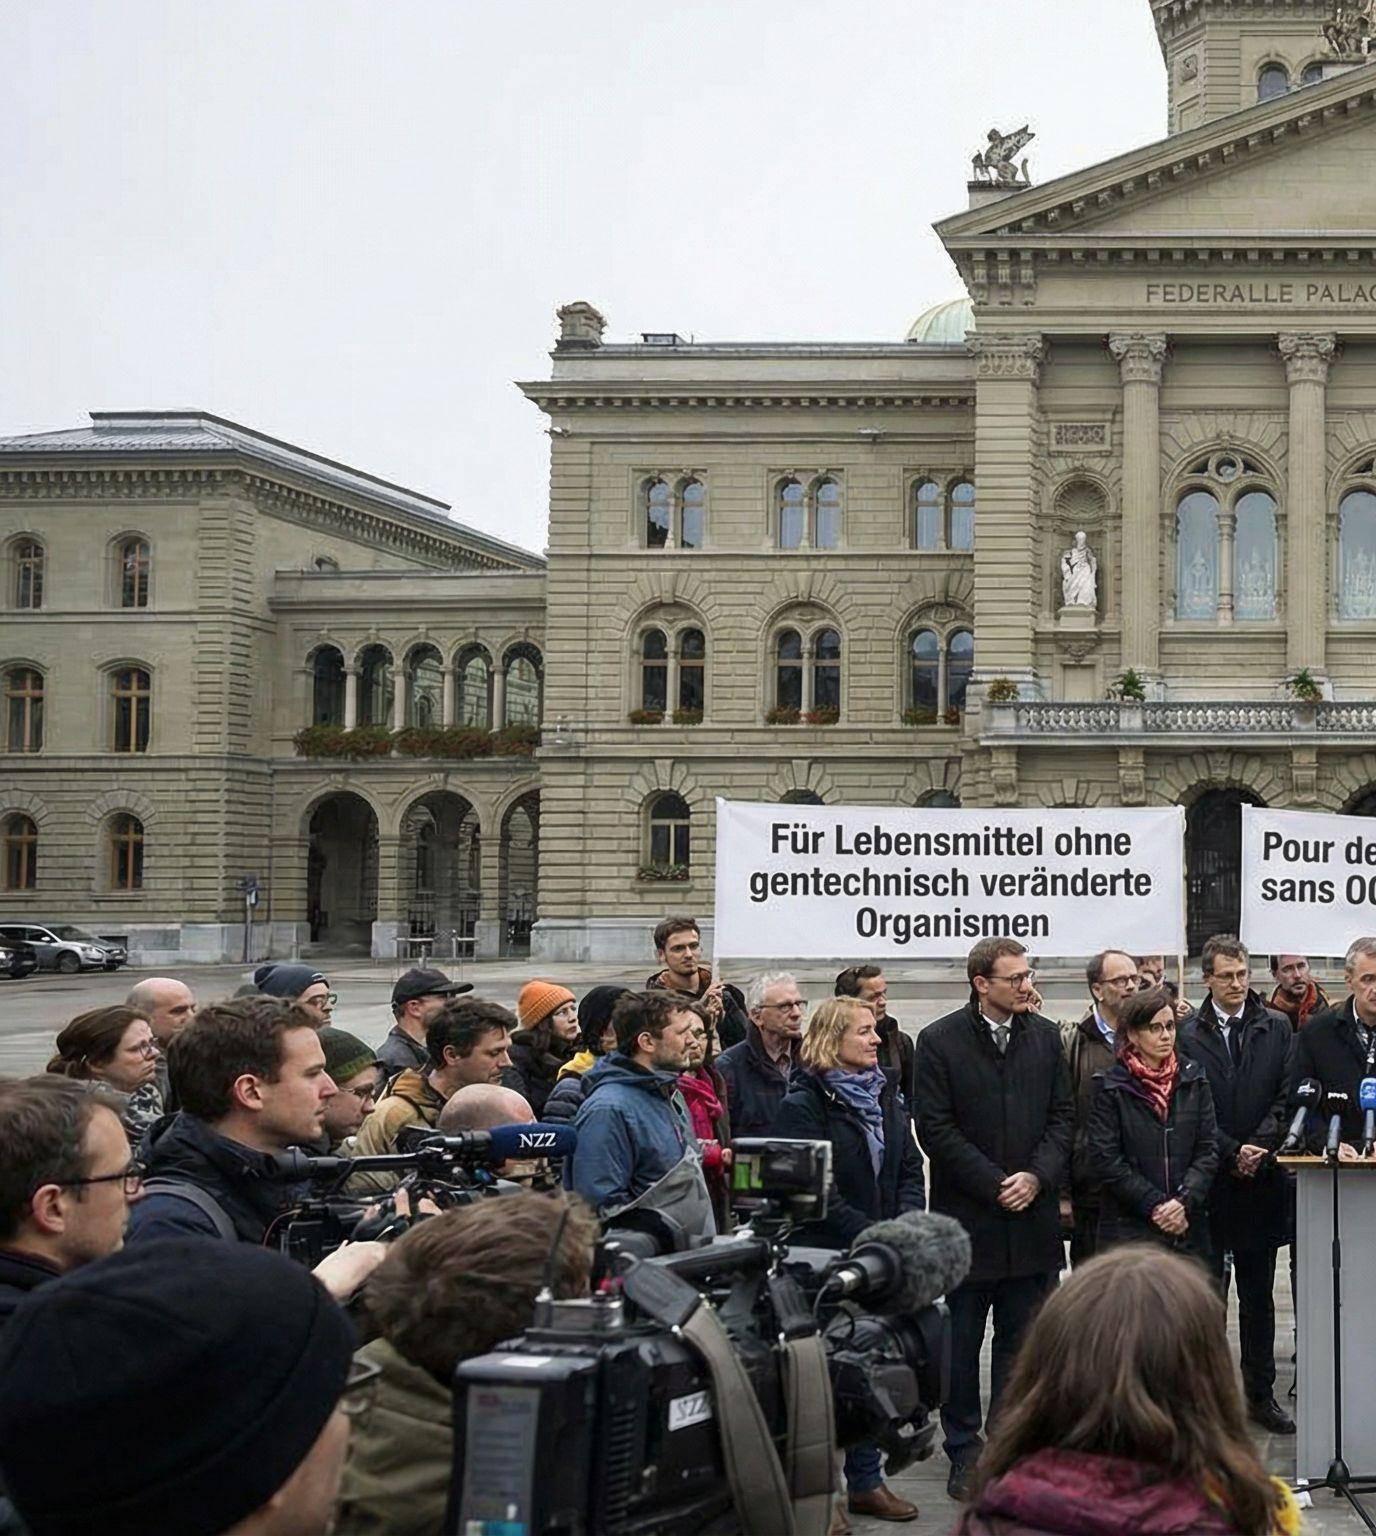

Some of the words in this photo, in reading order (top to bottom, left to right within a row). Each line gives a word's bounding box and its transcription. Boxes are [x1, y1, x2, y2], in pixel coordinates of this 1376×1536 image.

[1146, 284, 1293, 303] FEDERALLE
[771, 823, 825, 855] Für
[835, 824, 1043, 856] Lebensmittel
[1054, 826, 1131, 856] ohne
[1263, 831, 1335, 863] Pour
[750, 866, 969, 902] gentechnisch
[980, 866, 1152, 897] veränderte
[1261, 878, 1335, 904] sans
[856, 907, 1049, 944] Organismen
[518, 1132, 557, 1149] NZZ
